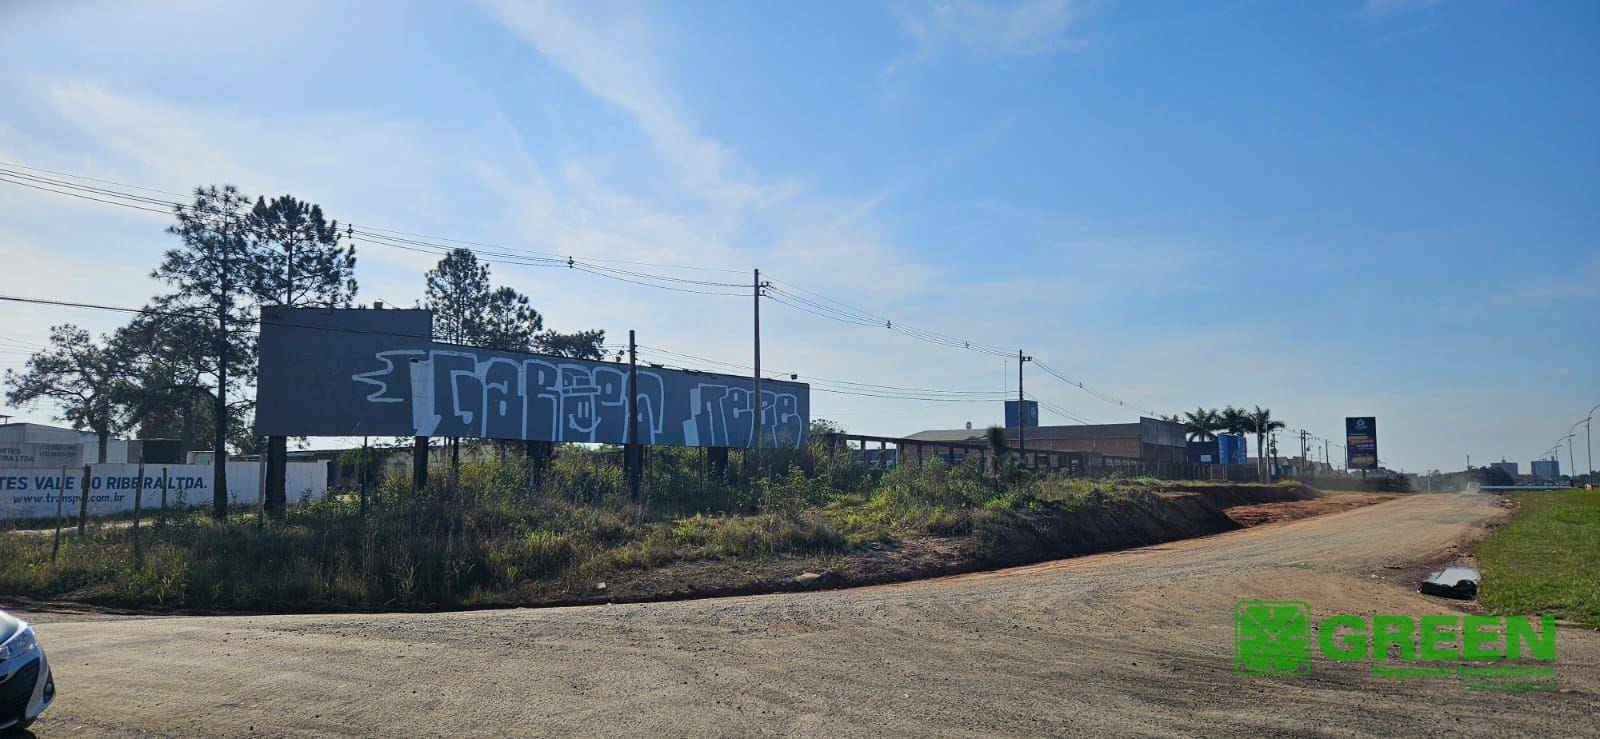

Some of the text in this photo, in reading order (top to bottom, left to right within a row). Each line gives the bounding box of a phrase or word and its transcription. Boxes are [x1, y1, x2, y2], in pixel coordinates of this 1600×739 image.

[35, 476, 75, 490] VALE
[106, 476, 163, 490] RIBERA
[167, 476, 208, 490] LTDA.
